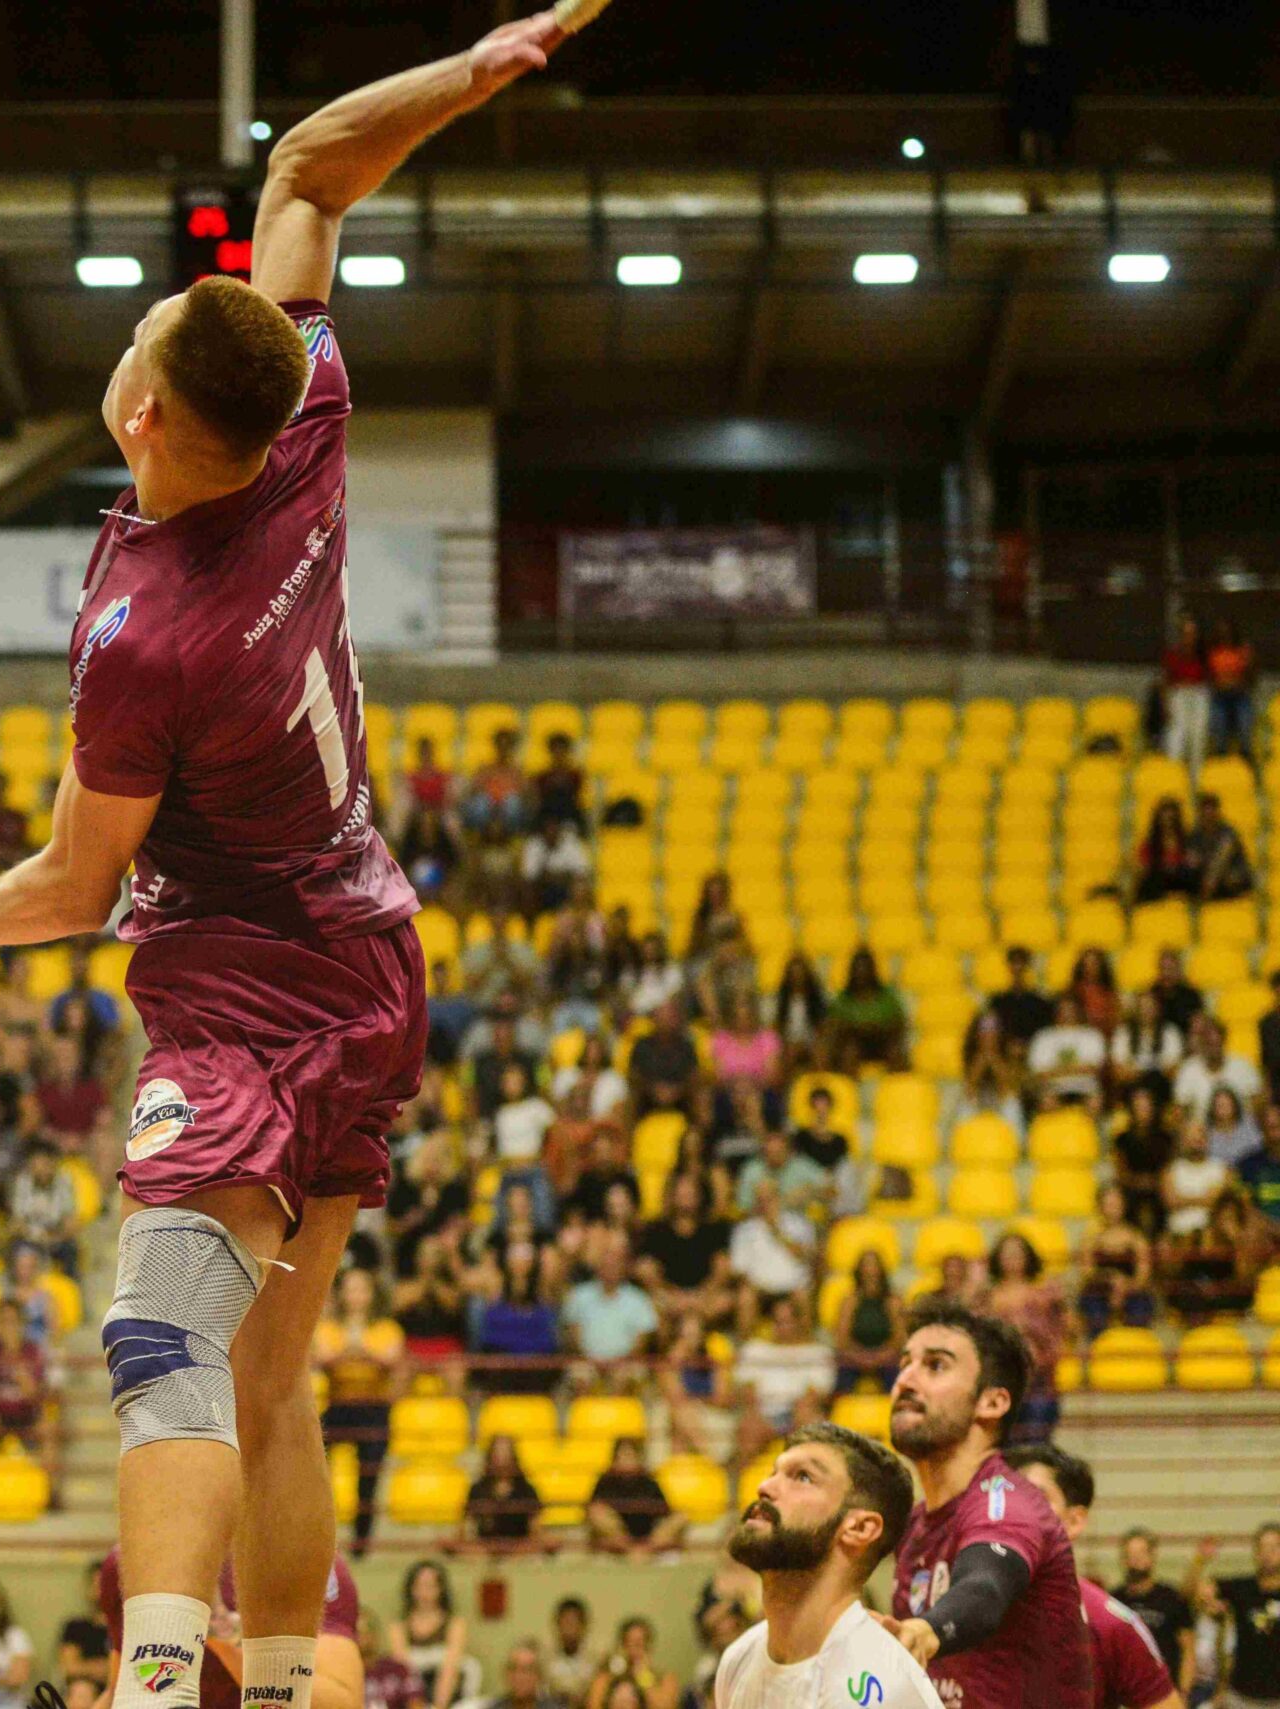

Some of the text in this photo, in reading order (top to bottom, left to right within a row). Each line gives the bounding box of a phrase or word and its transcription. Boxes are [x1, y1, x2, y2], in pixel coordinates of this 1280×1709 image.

[242, 559, 312, 649] Juiz de Fora
[158, 1107, 177, 1119] Cia
